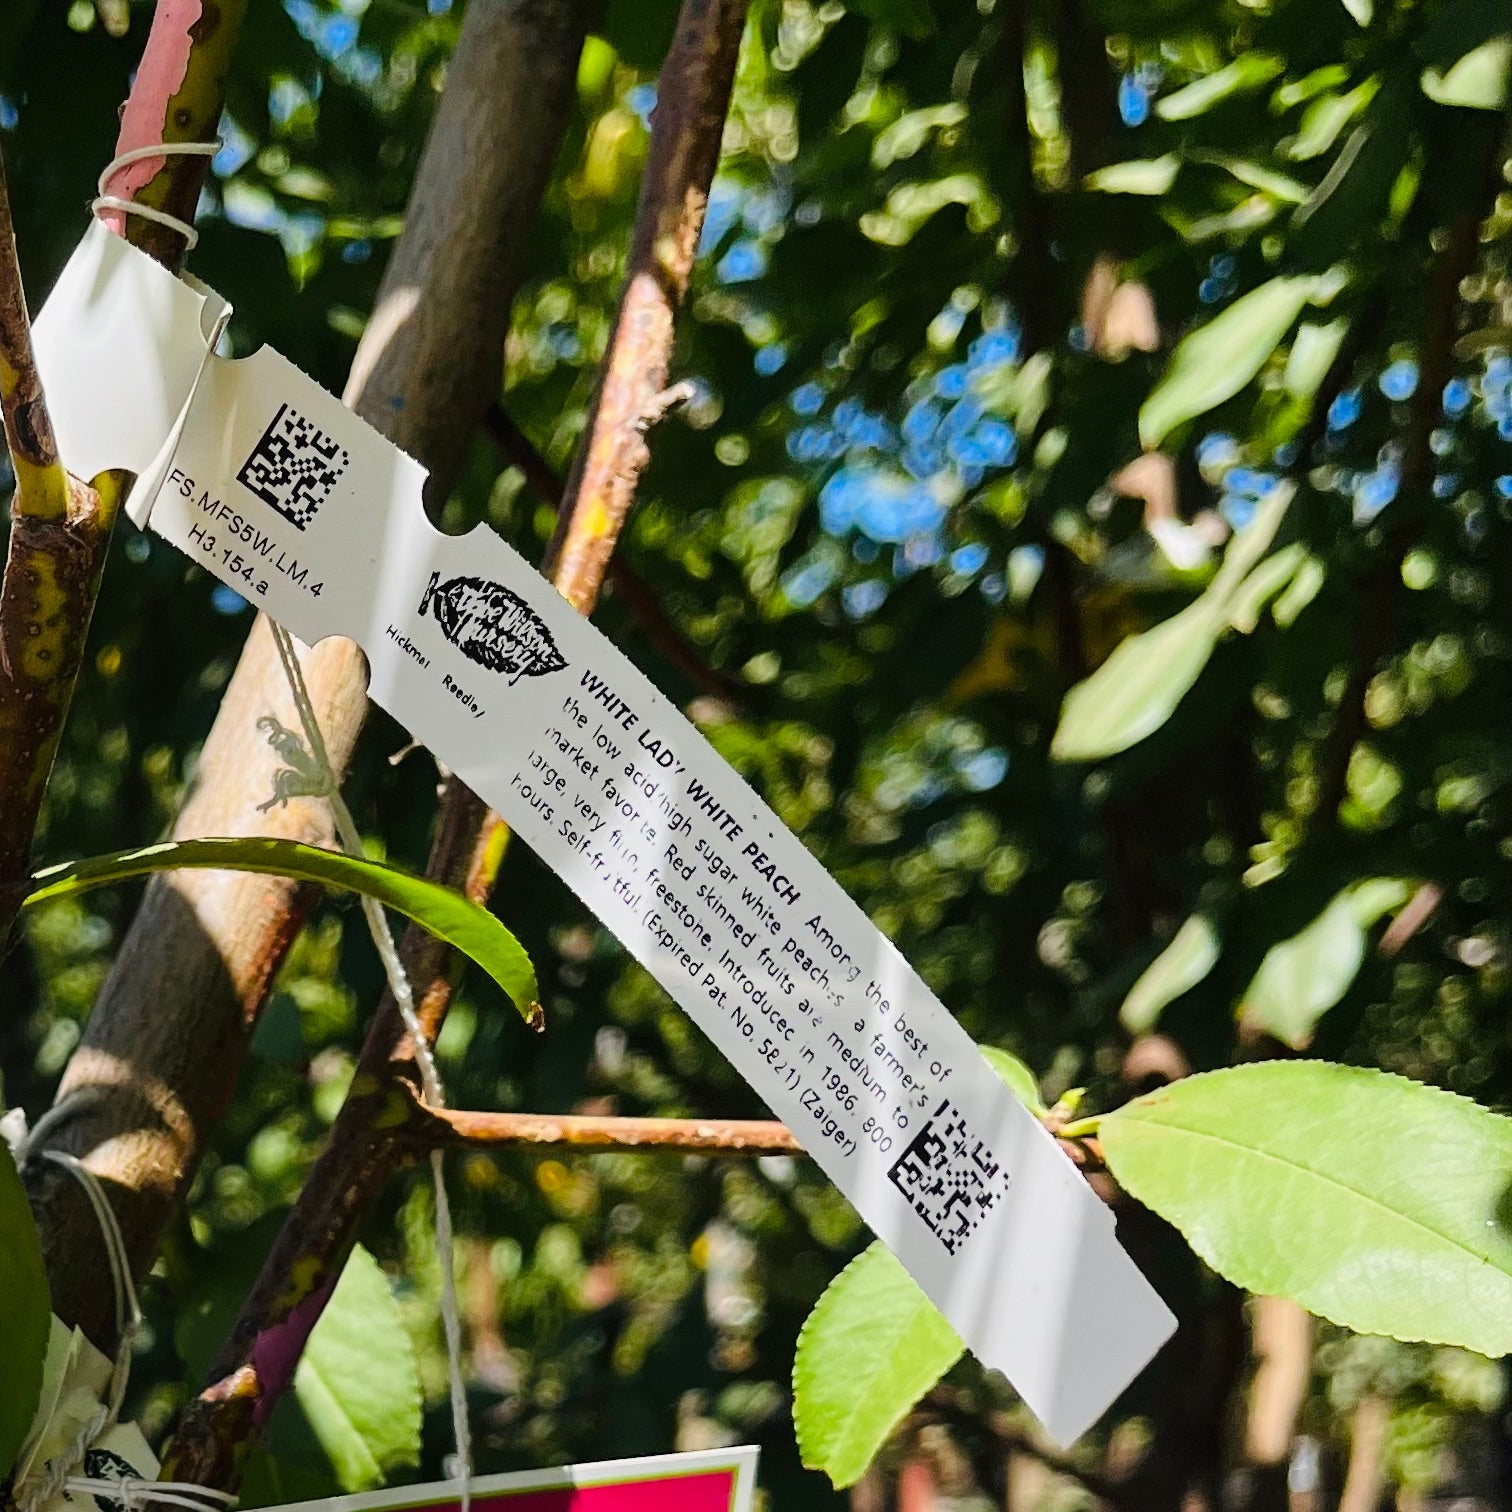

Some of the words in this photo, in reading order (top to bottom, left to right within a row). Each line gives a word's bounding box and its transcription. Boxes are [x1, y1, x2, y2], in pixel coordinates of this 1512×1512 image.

[188, 522, 270, 598] H3.154.a
[545, 722, 600, 780] market
[598, 777, 663, 845] favorte.
[662, 845, 696, 880] Red
[694, 882, 756, 948] skinned
[754, 948, 799, 994] fruits
[823, 1031, 891, 1102] medium
[890, 1105, 913, 1129] to
[561, 697, 591, 727] the
[590, 726, 623, 759] low
[691, 838, 738, 887] sugar
[738, 886, 785, 934] white
[853, 1018, 867, 1031] a
[865, 1034, 935, 1107] farmer's
[568, 794, 604, 832] very
[642, 870, 719, 951] freestone.
[798, 1042, 818, 1062] in
[580, 670, 637, 730] WHITE
[685, 780, 742, 840] WHITE
[742, 843, 800, 904] PEACH
[863, 980, 895, 1013] the
[891, 1015, 931, 1057] best
[928, 1058, 951, 1081] of
[640, 910, 703, 976] (Expired
[699, 974, 733, 1008] Pat.
[729, 1008, 761, 1041] No.
[795, 1089, 860, 1156] (Zaiger)
